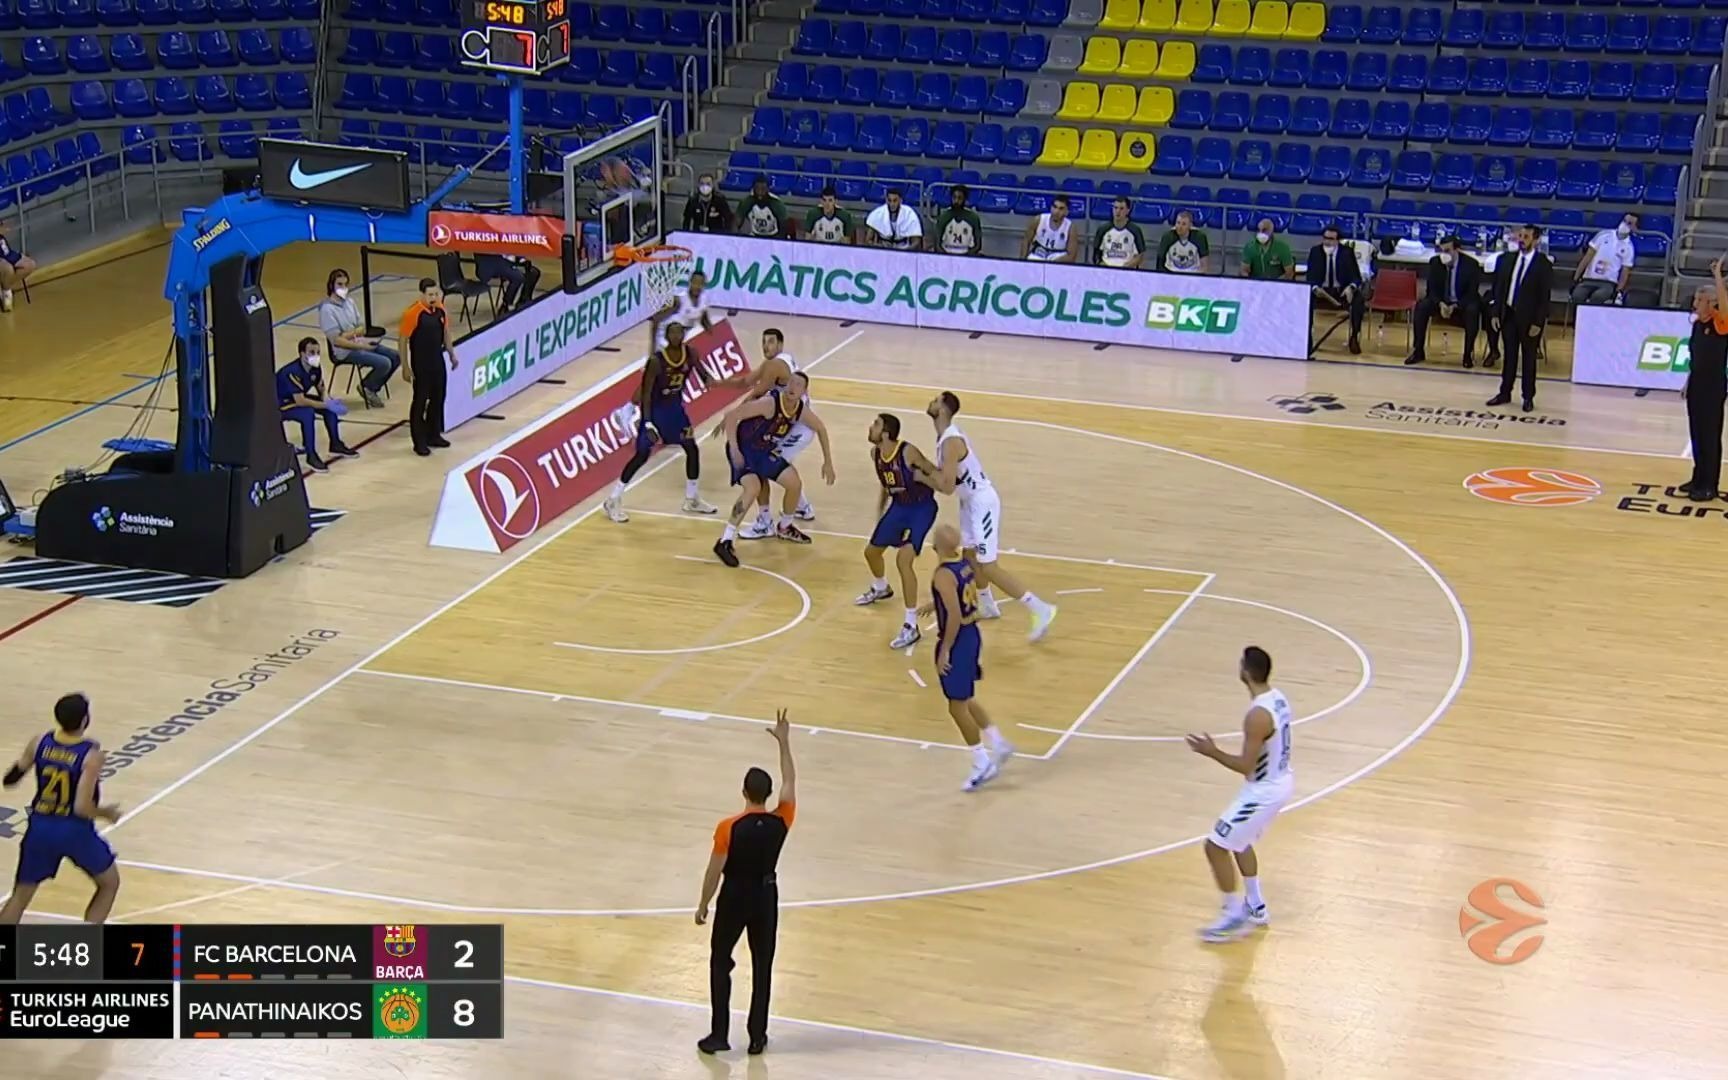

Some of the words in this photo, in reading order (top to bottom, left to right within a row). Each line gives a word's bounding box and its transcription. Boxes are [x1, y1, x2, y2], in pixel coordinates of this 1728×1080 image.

[514, 33, 533, 66] 7
[193, 218, 231, 252] SPALDING
[454, 231, 499, 242] TURKISH
[501, 233, 548, 245] AIRLINES
[884, 275, 1131, 327] AGRÍCOLES
[1147, 300, 1236, 328] BKT
[473, 349, 515, 391] BKT
[524, 289, 613, 368] L'EXPERT
[616, 273, 642, 317] EN
[42, 765, 71, 806] 21
